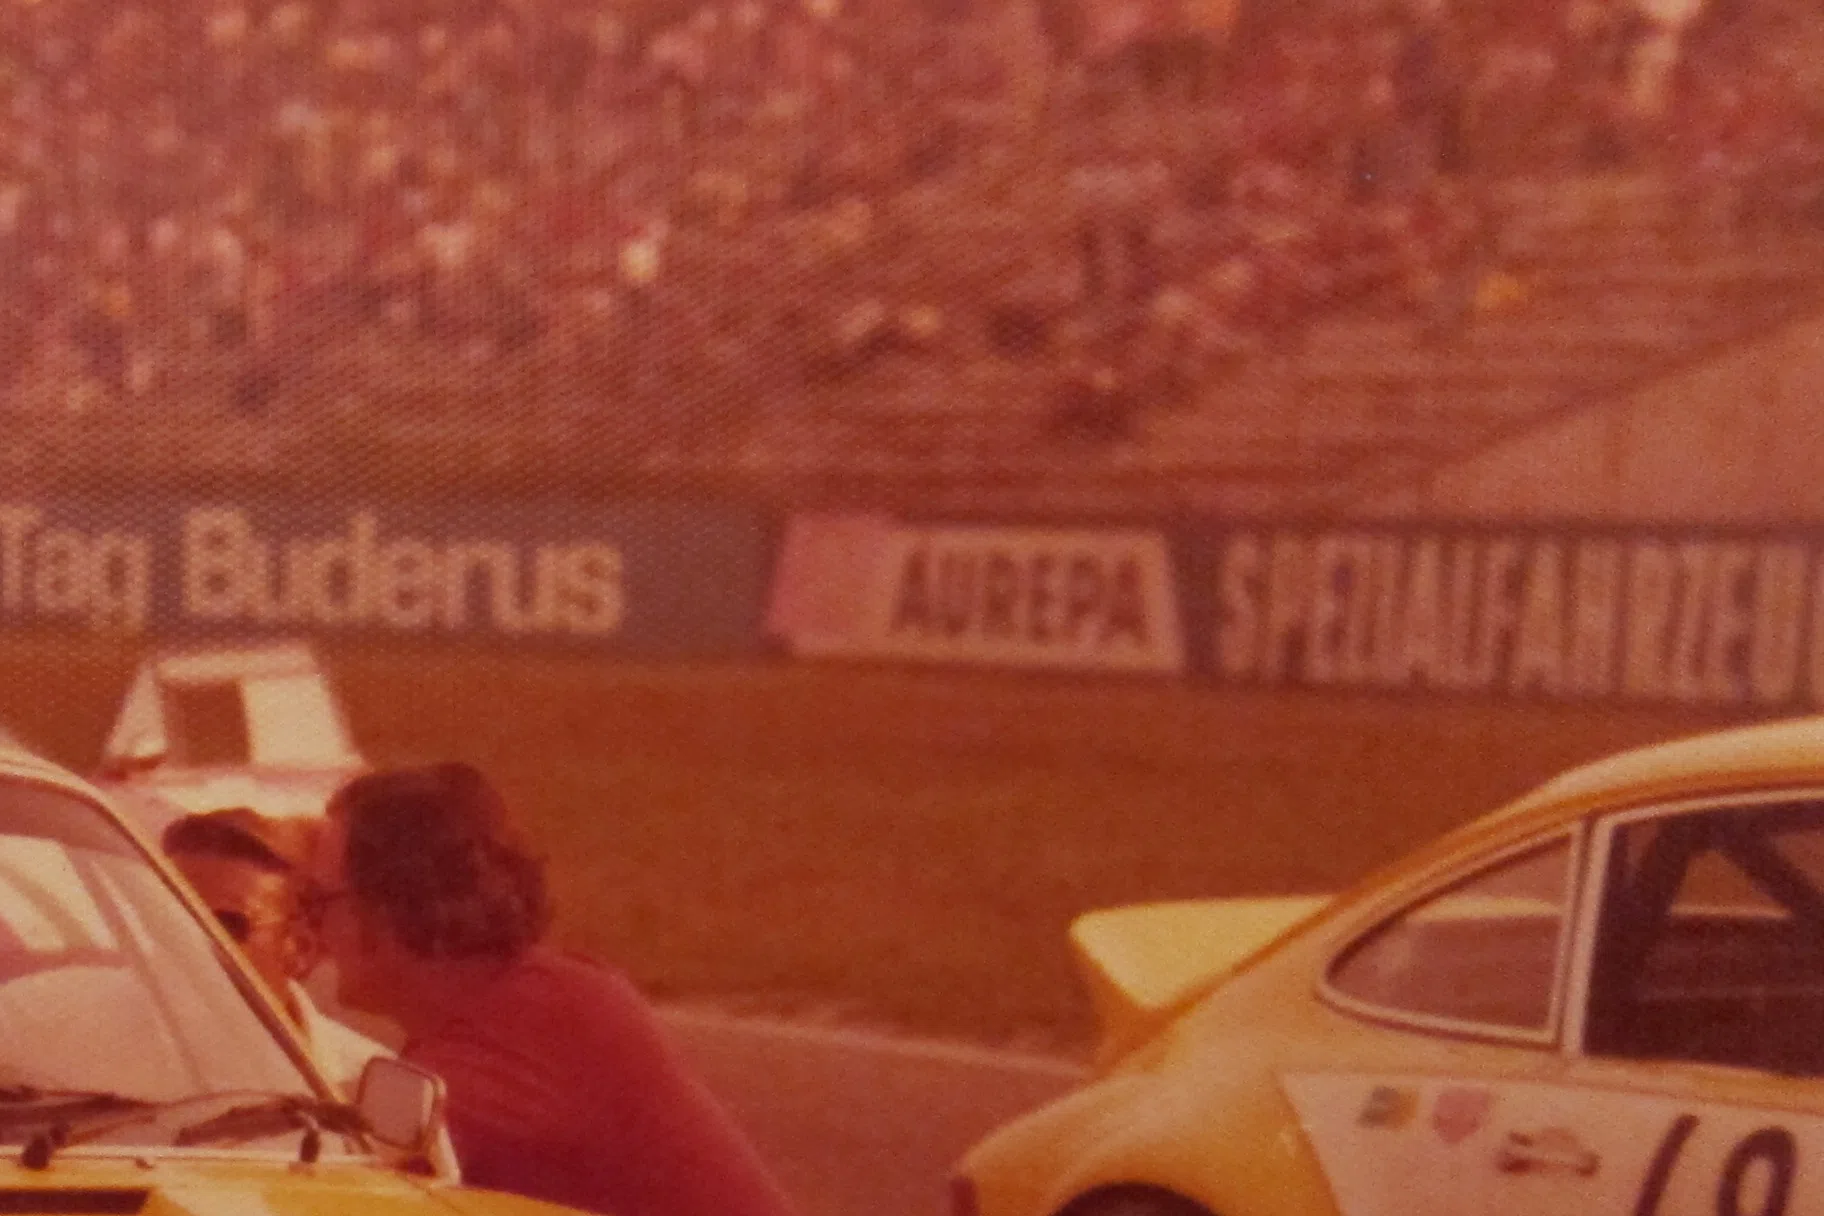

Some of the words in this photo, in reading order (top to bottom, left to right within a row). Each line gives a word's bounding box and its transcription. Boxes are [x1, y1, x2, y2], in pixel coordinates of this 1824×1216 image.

[179, 504, 623, 635] Buderus
[888, 545, 1152, 648] AUREPA
[1218, 530, 1824, 702] SPEZIALFAHRZEU
